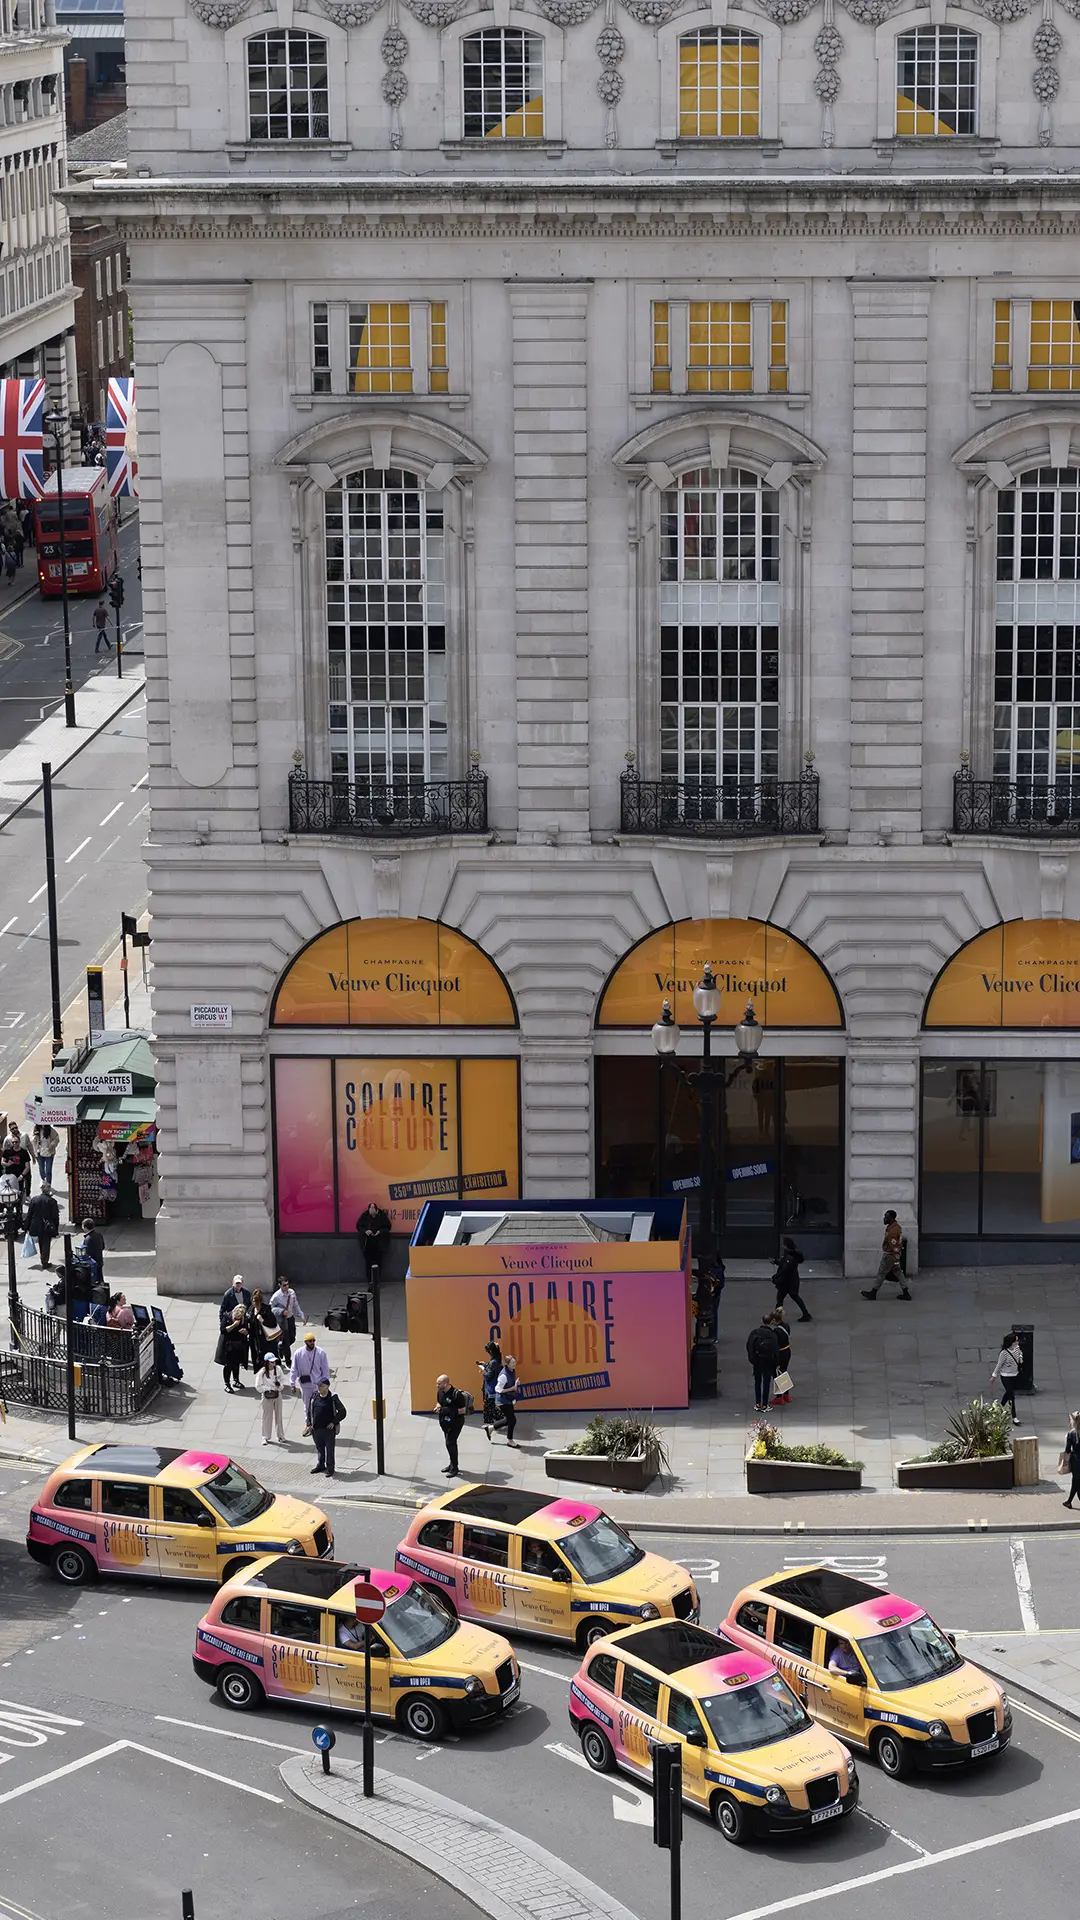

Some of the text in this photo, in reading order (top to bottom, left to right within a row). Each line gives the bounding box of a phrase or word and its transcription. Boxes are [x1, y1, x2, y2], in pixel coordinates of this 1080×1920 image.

[327, 972, 461, 996] Veuve Clicquot
[713, 973, 788, 996] Clicquot
[982, 974, 1034, 992] Veuve
[346, 1082, 448, 1116] SOLAIRE
[346, 1117, 448, 1150] CULTURE
[732, 1164, 767, 1179] OPENING SOON
[413, 1179, 458, 1196] ANNIVERSARY
[464, 1174, 502, 1189] EXHIBITION
[672, 1178, 694, 1191] OPENING
[501, 1255, 594, 1270] Veuve Clicquot
[488, 1280, 614, 1324] SOLAIRE
[522, 1381, 567, 1398] ANNIVERSARY
[568, 1374, 606, 1391] EXHIBITION
[36, 1515, 56, 1529] PICCADILLY
[78, 1532, 90, 1540] ENTRY
[104, 1521, 149, 1541] SOLAIRE
[104, 1538, 150, 1557] CULTURE
[400, 1554, 417, 1569] PICCADILLY
[438, 1573, 449, 1583] ENTRY
[464, 1566, 507, 1590] SOLAIRE
[464, 1585, 507, 1607] CULTURE
[202, 1633, 222, 1648] PICCADILLY
[246, 1654, 258, 1663] ENTRY
[272, 1644, 320, 1668] SOLAIRE
[272, 1662, 320, 1685] CULTURE
[619, 1710, 654, 1737] SOLAIRE
[888, 1713, 898, 1723] OPEN
